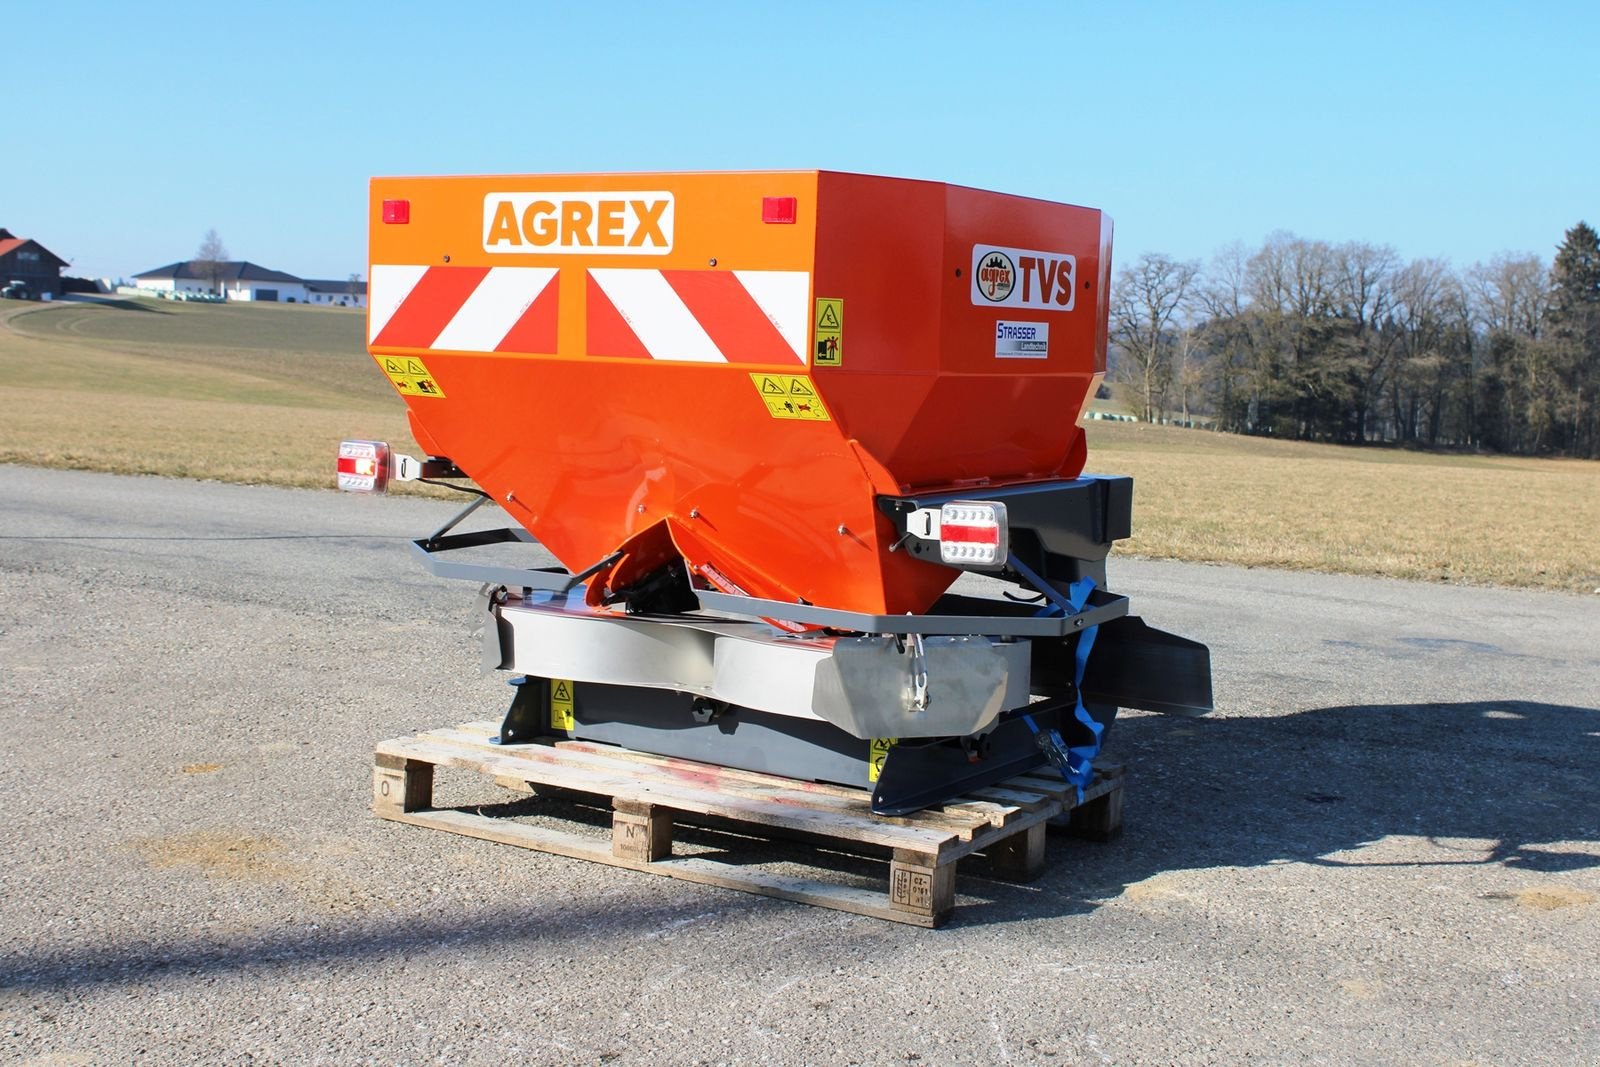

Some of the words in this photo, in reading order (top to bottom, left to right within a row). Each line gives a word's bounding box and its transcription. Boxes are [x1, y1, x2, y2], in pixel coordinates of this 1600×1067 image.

[486, 200, 670, 247] AGREX
[1019, 256, 1072, 306] TVS
[997, 323, 1036, 340] STRASSER
